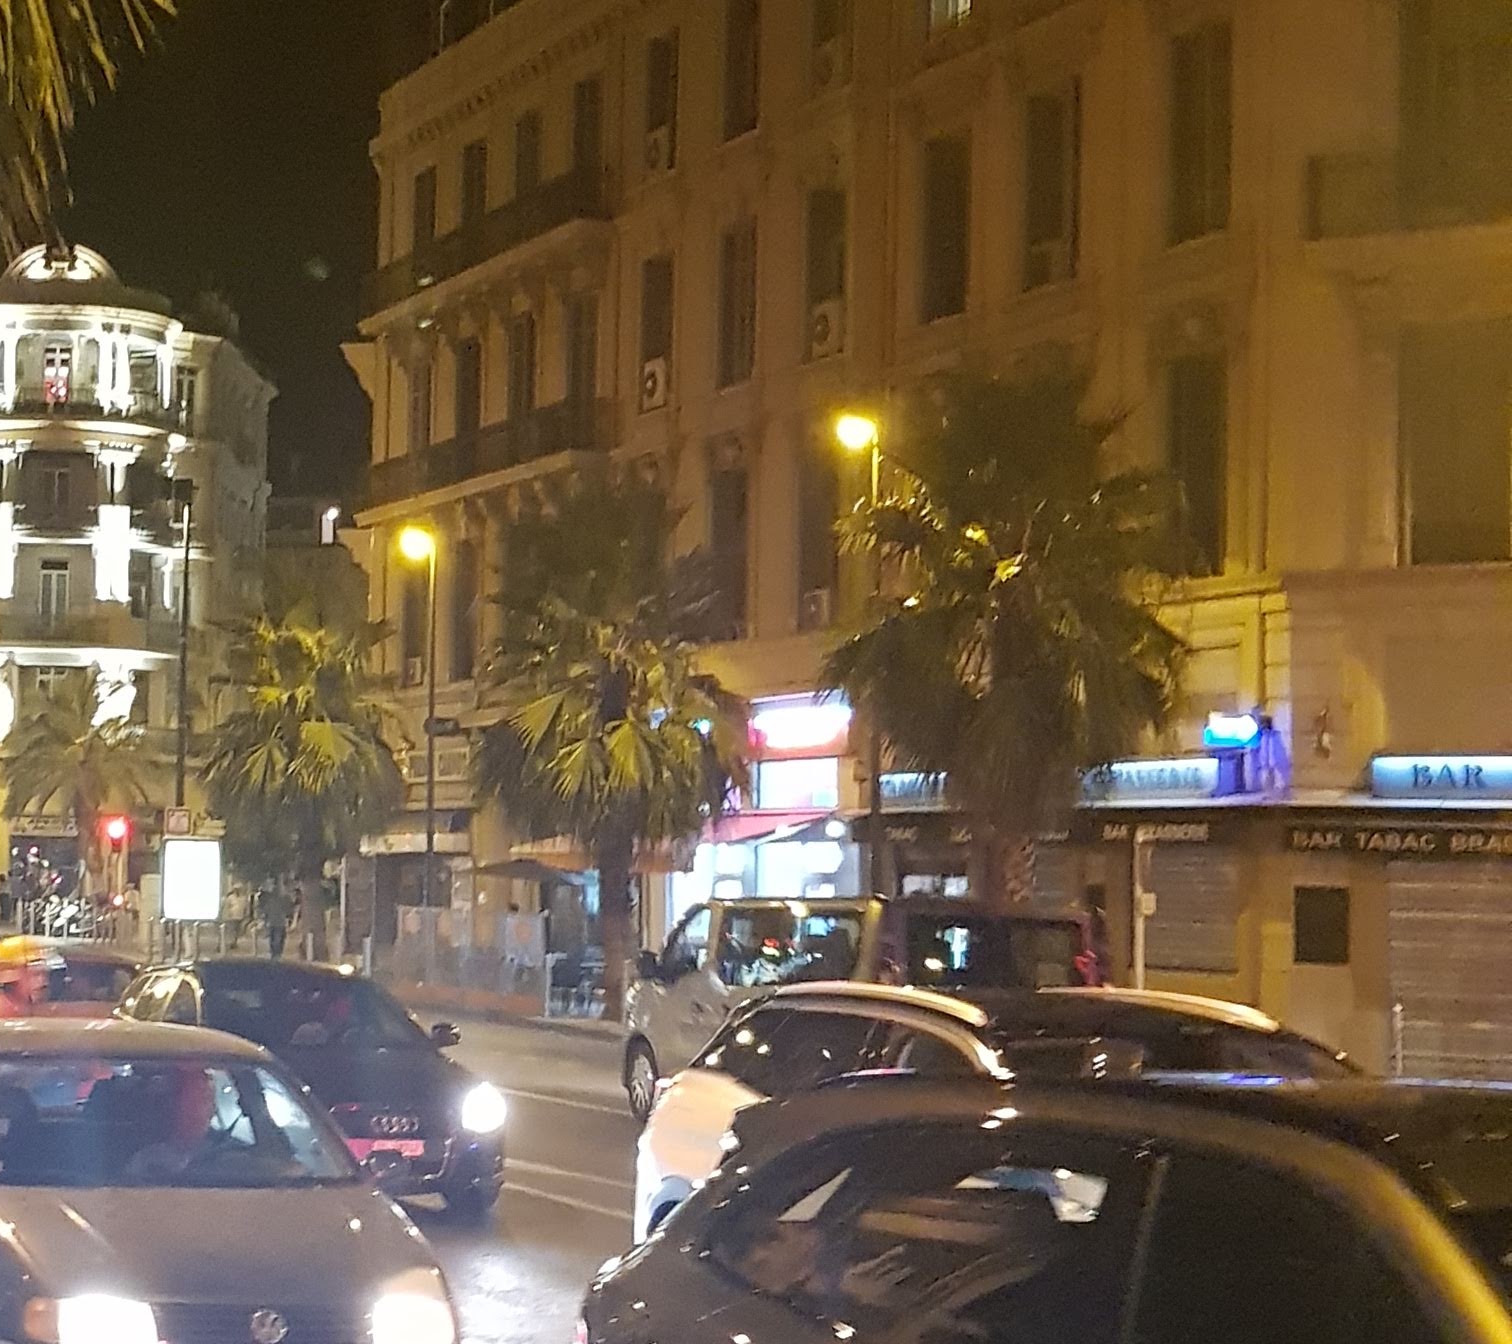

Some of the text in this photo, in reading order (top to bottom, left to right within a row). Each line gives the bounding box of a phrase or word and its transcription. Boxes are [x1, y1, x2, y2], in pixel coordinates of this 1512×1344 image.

[1410, 763, 1488, 788] BAR
[1293, 830, 1512, 852] BAR TABAC BRA
